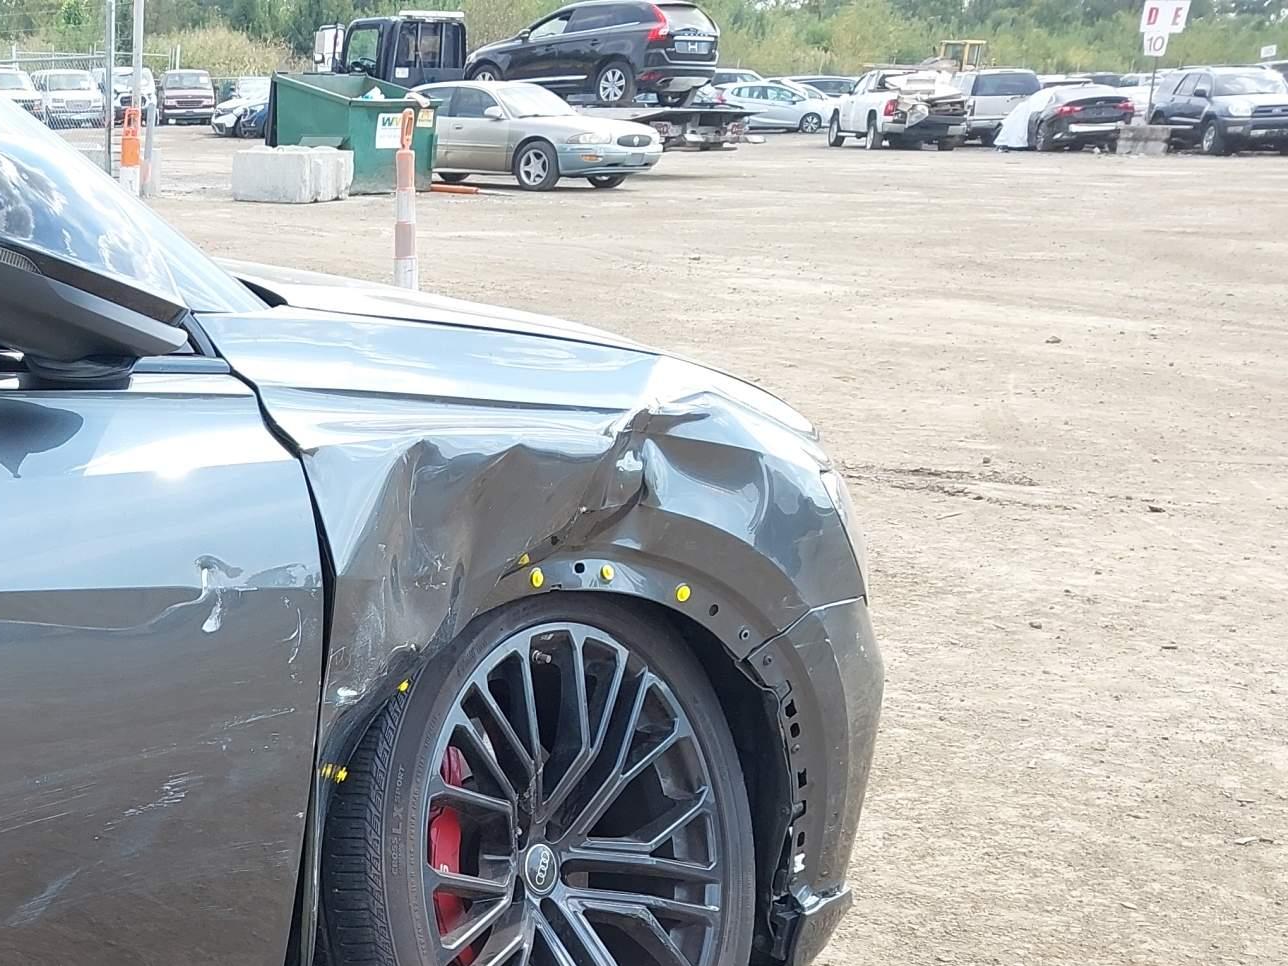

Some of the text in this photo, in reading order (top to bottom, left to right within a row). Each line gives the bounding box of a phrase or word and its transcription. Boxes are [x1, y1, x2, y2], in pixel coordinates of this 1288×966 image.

[1146, 7, 1184, 26] D E
[1146, 35, 1165, 53] 10
